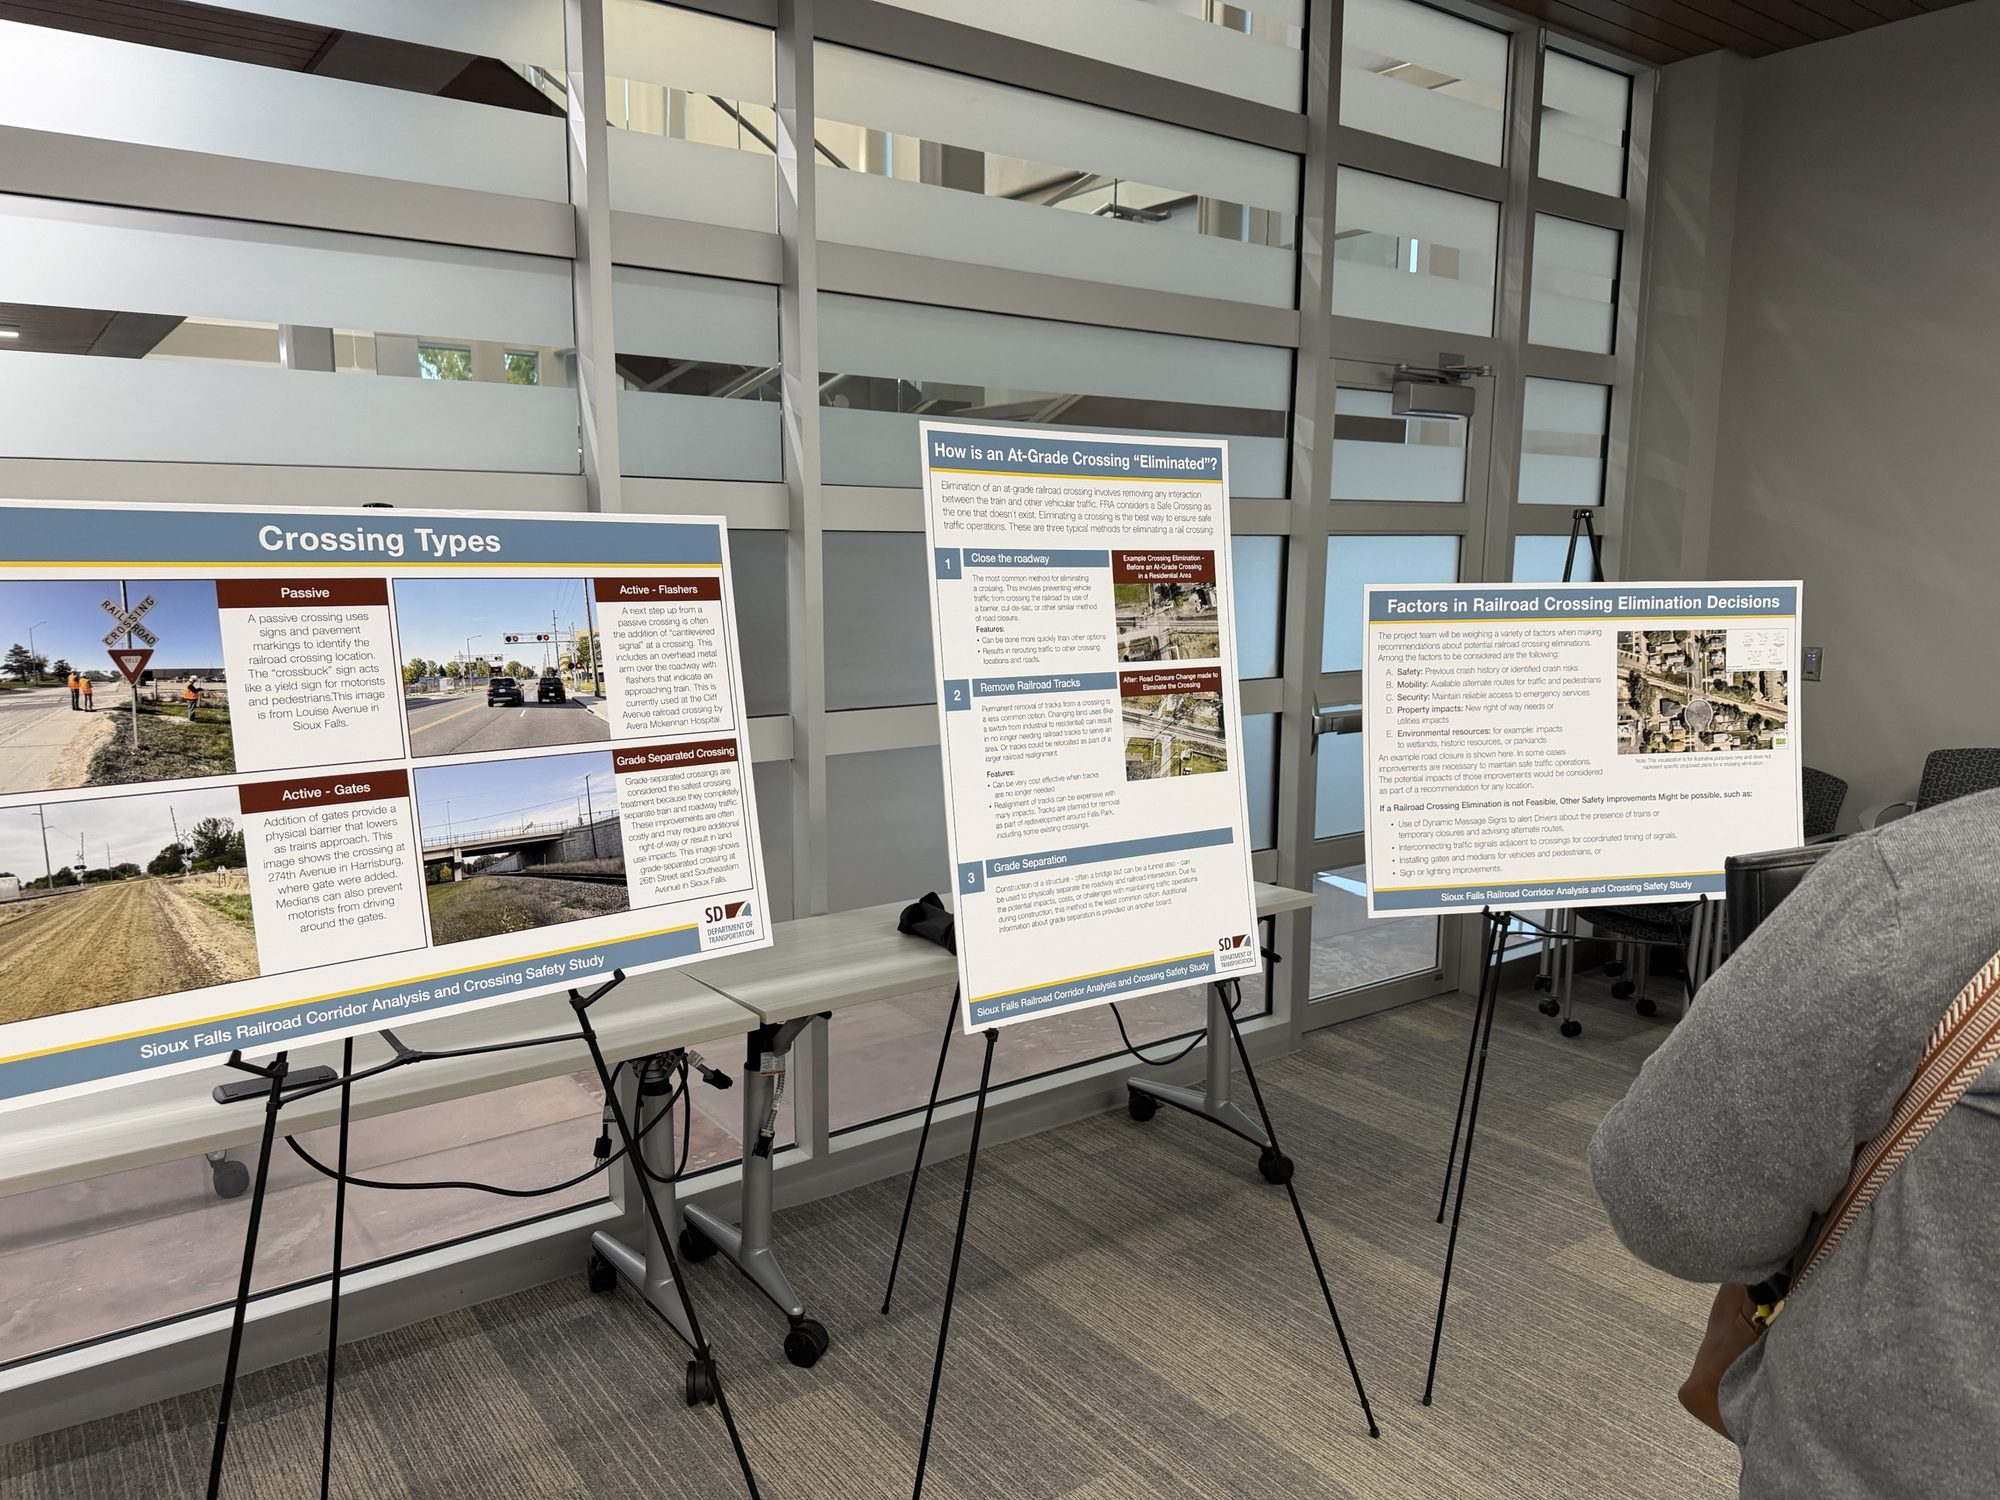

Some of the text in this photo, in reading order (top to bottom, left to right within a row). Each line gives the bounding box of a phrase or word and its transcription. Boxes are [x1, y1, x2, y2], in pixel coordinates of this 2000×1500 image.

[934, 442, 966, 458] How
[971, 445, 982, 459] is
[987, 449, 1003, 461] an
[1007, 447, 1068, 464] At-Grade
[1072, 451, 1130, 470] Crossing
[259, 525, 501, 557] Crossing Types
[945, 558, 951, 569] 1
[971, 552, 1049, 565] Close the roadway
[1123, 554, 1146, 562] Example
[1178, 563, 1202, 571] Crossing
[281, 587, 330, 598] Passive
[619, 585, 649, 594] Active
[658, 584, 698, 594] Flashers
[1388, 594, 1780, 613] Factors in Railroad Crossing Elimination Decisions
[104, 597, 155, 646] CROSSING
[247, 612, 369, 625] A passive crossing uses
[259, 626, 361, 639] signs and pavement
[976, 625, 1005, 633] Features:
[253, 638, 370, 652] markings to identify the
[249, 651, 375, 665] railroad crossing location.
[247, 669, 268, 678] The
[335, 665, 356, 676] sign
[359, 664, 379, 673] acts
[1396, 668, 1423, 677] Safety:
[1425, 667, 1454, 675] Previous
[1477, 666, 1500, 674] history
[1510, 665, 1541, 673] identified
[244, 677, 386, 693] like a yield sign for motorists
[980, 678, 1080, 692] Remove Railroad Tracks
[248, 696, 269, 707] and
[355, 691, 385, 701] image
[954, 689, 961, 701] 2
[257, 703, 379, 719] is from Louise Avenue in
[293, 719, 349, 731] Sioux Falls.
[616, 746, 735, 766] Grade Separated Crossing
[986, 770, 1015, 778] Features:
[282, 788, 322, 801] Active
[334, 783, 371, 795] Gates
[1379, 804, 1385, 812] If
[1393, 803, 1424, 811] Railroad
[1426, 802, 1459, 811] Crossing
[1461, 801, 1501, 809] Elimination
[1525, 798, 1558, 806] Feasible,
[1581, 796, 1605, 804] Safety
[1606, 794, 1656, 804] Improvements
[1658, 793, 1678, 801] Might
[1690, 791, 1722, 800] possible,
[263, 805, 396, 828] Addition of gates provide a
[994, 855, 1067, 872] Grade Separation
[968, 872, 975, 884] 3
[1441, 880, 1692, 901] Sioux Falls Railroad Corridor Analysis and Crossing Safety Study
[705, 906, 723, 924] SD
[707, 921, 753, 936] DEPARTMENT OF
[708, 930, 755, 943] TRANSPORTATION
[1218, 937, 1232, 951] SD
[977, 962, 1209, 1017] Sioux Falls Railroad Corridor Analysis and Crossing Safety Study
[140, 954, 604, 1058] Sioux Falls Railroad Corridor Analysis and Crossing Safety Study
